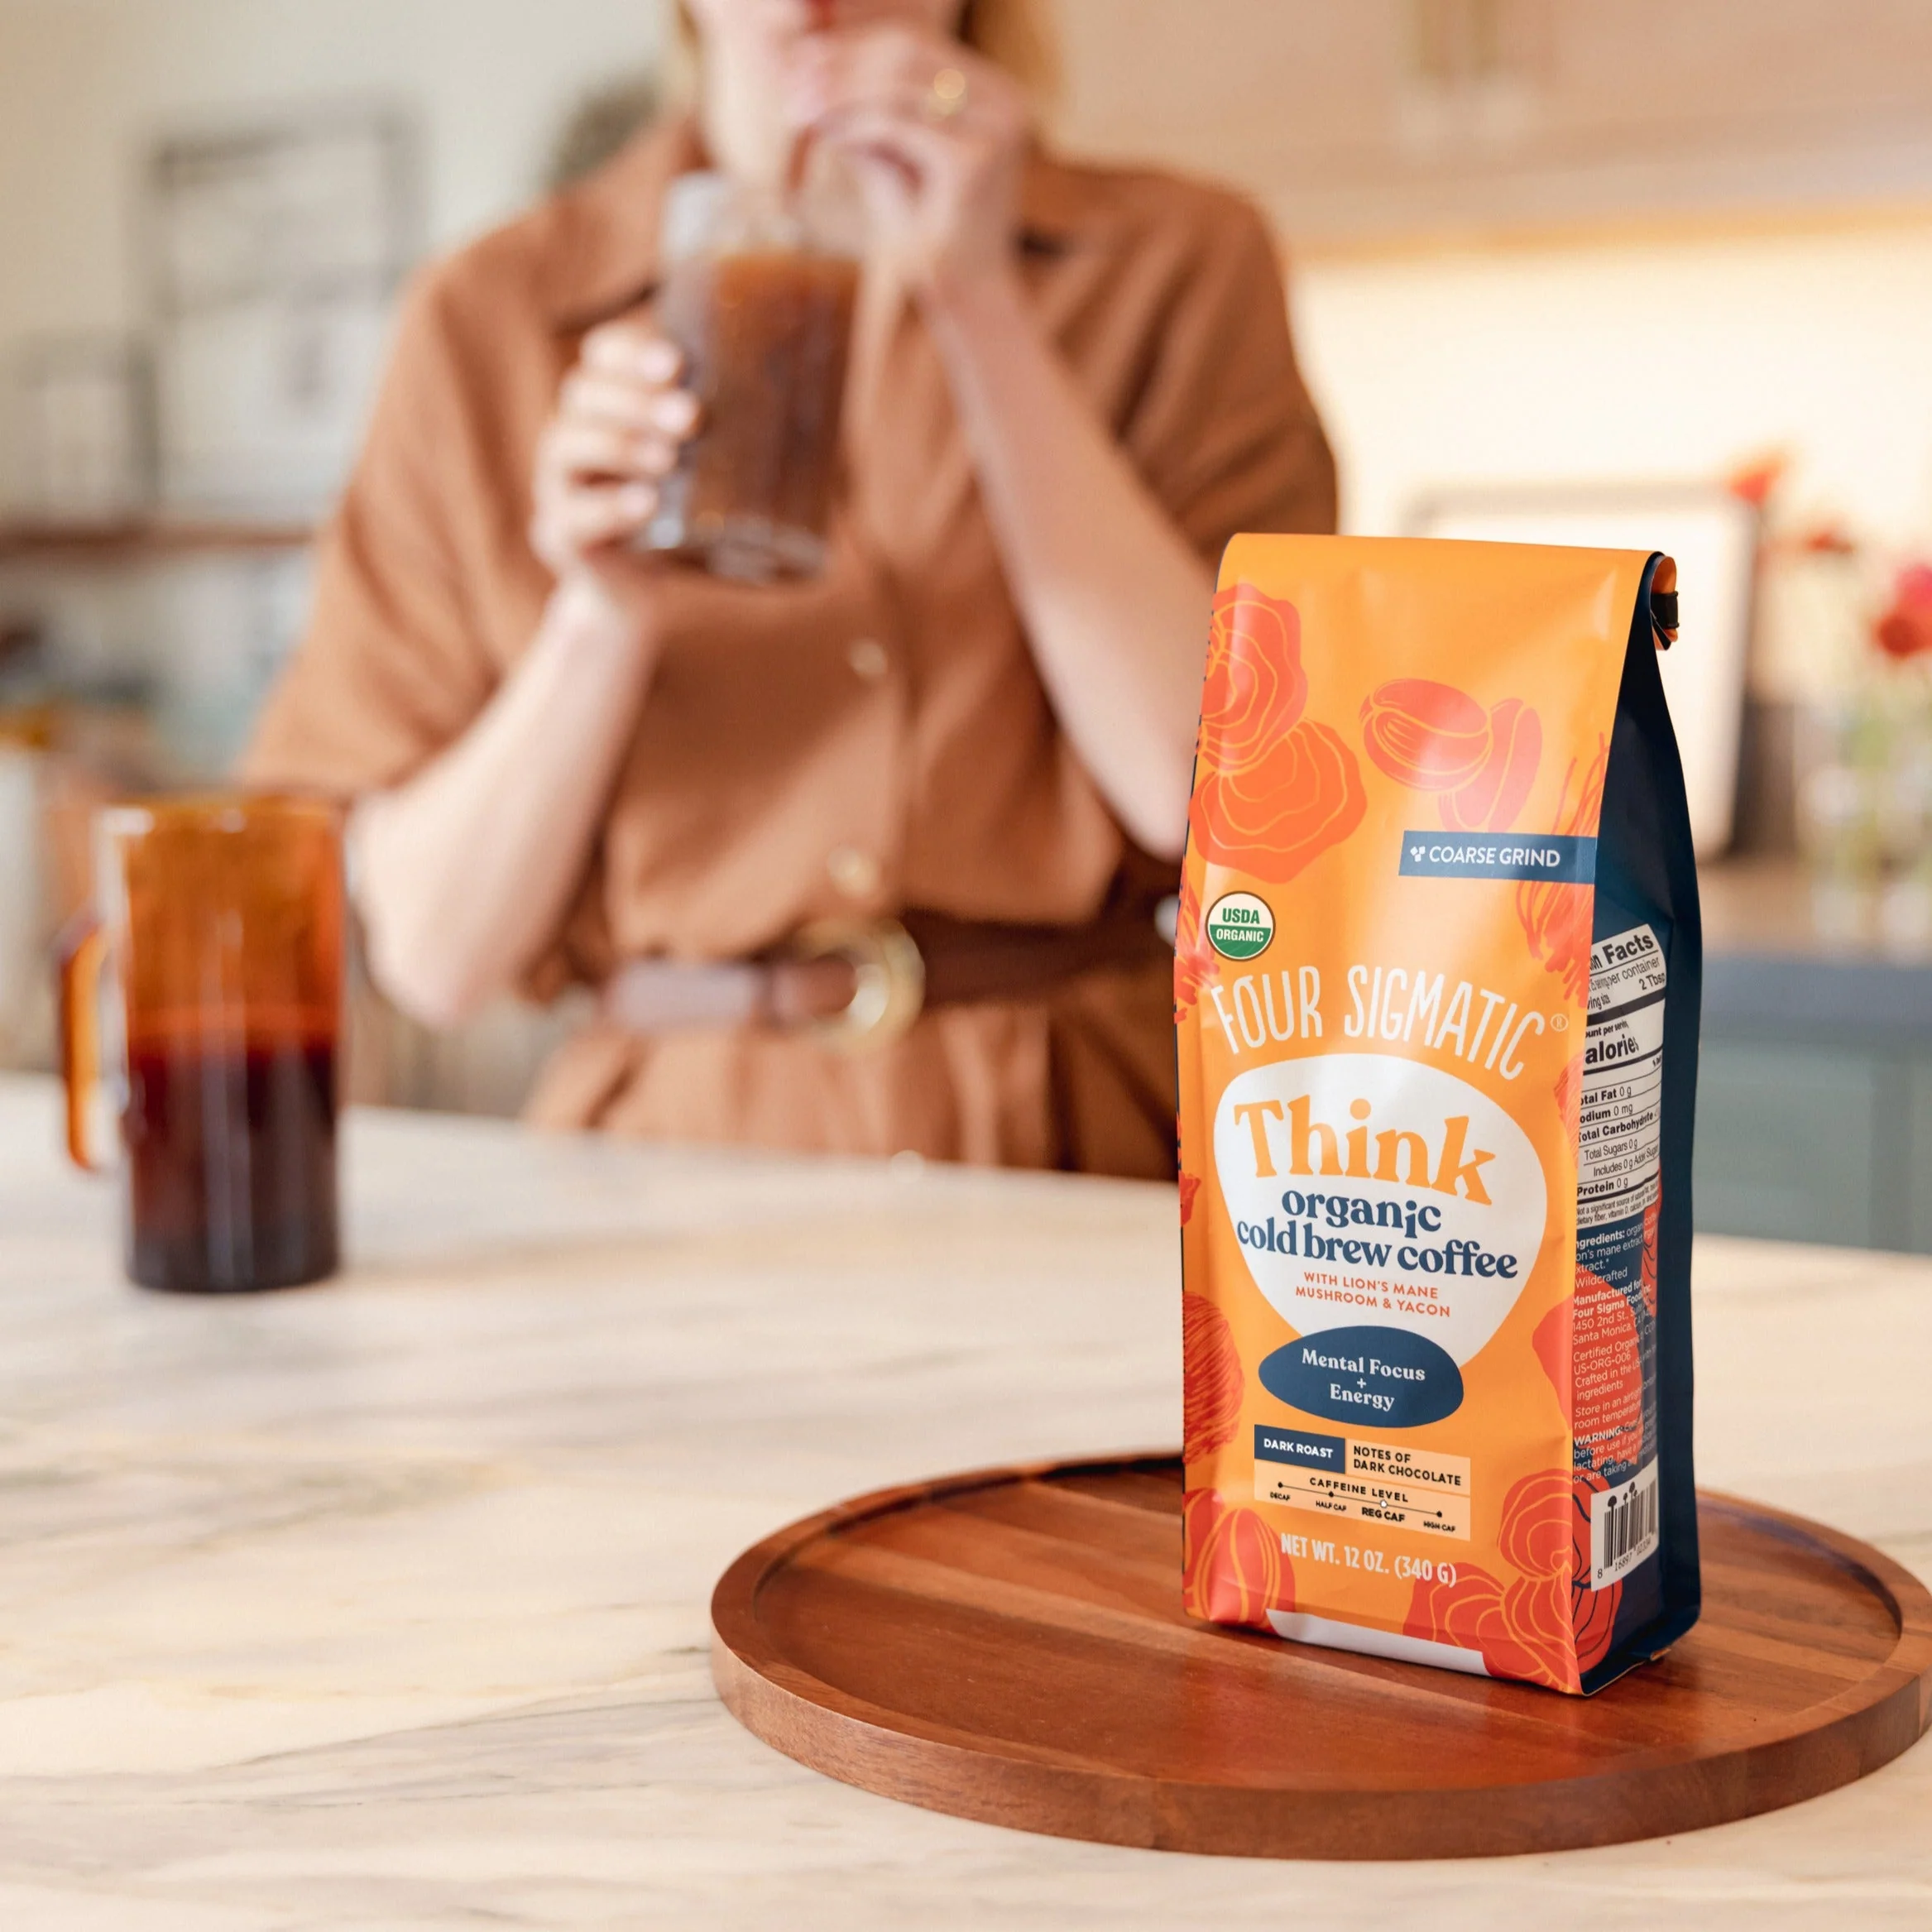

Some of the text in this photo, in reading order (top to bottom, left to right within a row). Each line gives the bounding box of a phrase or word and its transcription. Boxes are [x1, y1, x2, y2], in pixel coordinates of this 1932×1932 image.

[1429, 846, 1560, 867] COARSE GRIND
[1222, 908, 1260, 924] USDA
[1215, 928, 1264, 942] ORGANIC
[1602, 934, 1654, 965] Facts
[1622, 956, 1661, 980] container
[1639, 979, 1647, 990] 2
[1210, 966, 1323, 1054] FOUR
[1603, 1024, 1613, 1037] per
[1601, 1088, 1617, 1101] Fat
[1619, 1086, 1624, 1096] 0
[1627, 1086, 1631, 1099] g
[1580, 1104, 1632, 1124] odium 0 mg
[1234, 1094, 1496, 1206] Think
[1584, 1139, 1637, 1160] Total Sugars 0 g
[1594, 1162, 1622, 1177] Includes
[1623, 1158, 1628, 1169] 0
[1629, 1158, 1633, 1170] g
[1577, 1177, 1628, 1196] Protein 0 g
[1282, 1190, 1441, 1239] organic
[1590, 1200, 1616, 1215] significant
[1237, 1216, 1518, 1278] cold brew coffee
[1596, 1244, 1621, 1258] mane
[1304, 1272, 1438, 1299] WITH LION'S MANE
[1575, 1267, 1628, 1288] Wildcrafted
[1296, 1286, 1450, 1317] MUSHROOM & YACON
[1573, 1281, 1632, 1306] Manufactured
[1573, 1307, 1594, 1320] Four
[1596, 1300, 1625, 1314] Sigma
[1573, 1318, 1594, 1332] 1450
[1597, 1312, 1614, 1326] 2nd
[1573, 1332, 1599, 1345] Santa
[1573, 1344, 1613, 1363] Certified
[1574, 1350, 1631, 1375] US-ORG-006
[1302, 1348, 1426, 1381] Mental Focus
[1575, 1370, 1608, 1388] Crafted
[1610, 1369, 1618, 1378] in
[1620, 1364, 1632, 1375] the
[1330, 1383, 1395, 1412] Energy
[1576, 1380, 1623, 1401] ingredients
[1575, 1405, 1600, 1417] Store
[1603, 1401, 1610, 1411] in
[1612, 1397, 1622, 1407] an
[1575, 1417, 1600, 1430] room
[1574, 1425, 1623, 1446] WARNING:
[1263, 1438, 1333, 1459] DARK ROAST
[1354, 1445, 1411, 1463] NOTES OF
[1573, 1445, 1604, 1459] before
[1607, 1440, 1620, 1451] use
[1622, 1436, 1627, 1445] if
[1573, 1454, 1615, 1471] lactating,
[1617, 1445, 1632, 1460] have
[1354, 1459, 1461, 1486] DARK CHOCOLATE
[1573, 1475, 1583, 1484] or
[1586, 1470, 1602, 1481] are
[1604, 1462, 1627, 1477] taking
[1269, 1491, 1291, 1502] DECAF
[1309, 1477, 1409, 1503] CAFFEINE LEVEL
[1316, 1499, 1347, 1512] HALF CAF
[1361, 1507, 1405, 1522] REG CAF
[1423, 1521, 1455, 1532] HIGH CAF
[1280, 1533, 1456, 1588] NET WT. 12 OZ. (340 G)
[1597, 1568, 1603, 1579] 8
